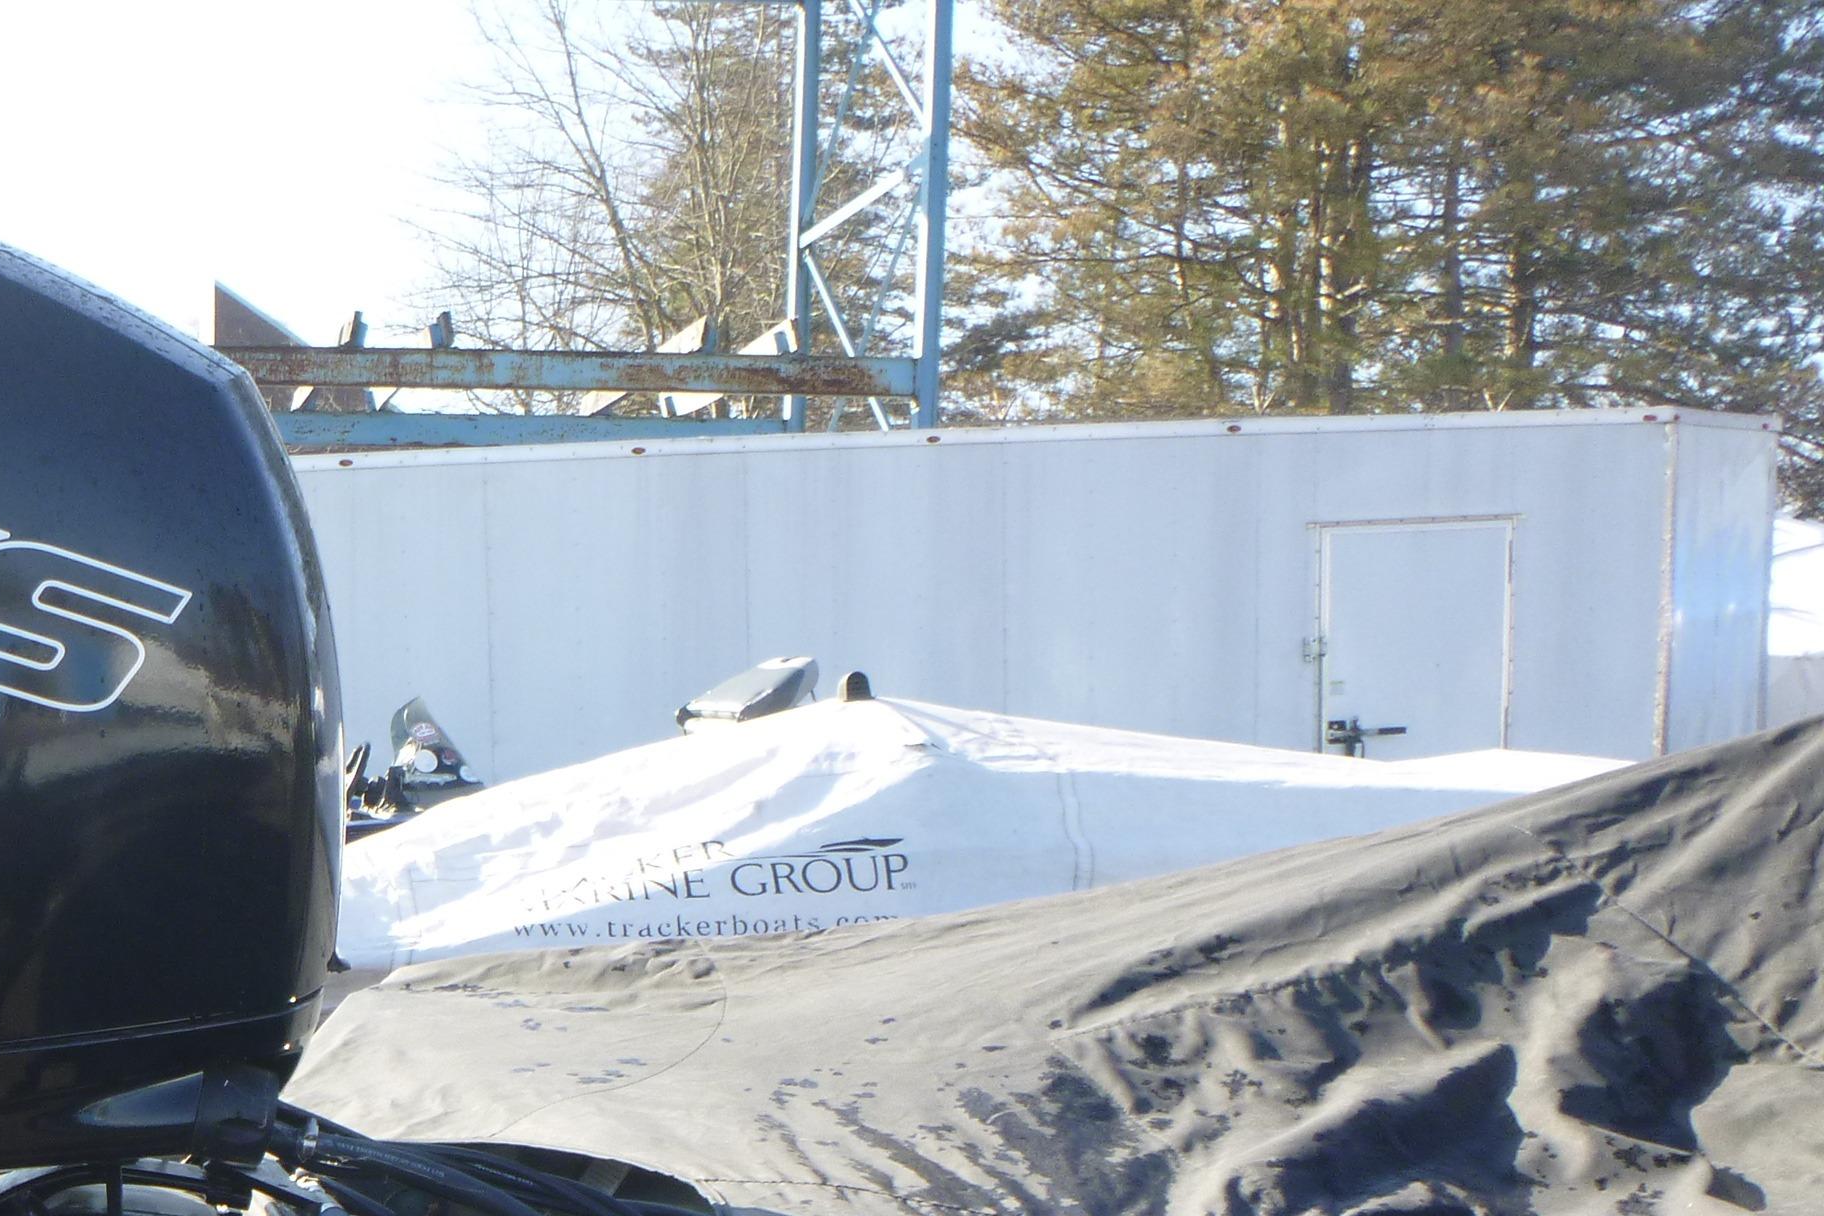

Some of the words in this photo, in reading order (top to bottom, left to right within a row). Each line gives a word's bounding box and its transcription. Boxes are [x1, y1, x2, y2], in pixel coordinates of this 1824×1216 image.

[520, 867, 711, 912] ARINE
[730, 853, 909, 897] GROUP
[513, 912, 899, 938] www.trackerboatsc
